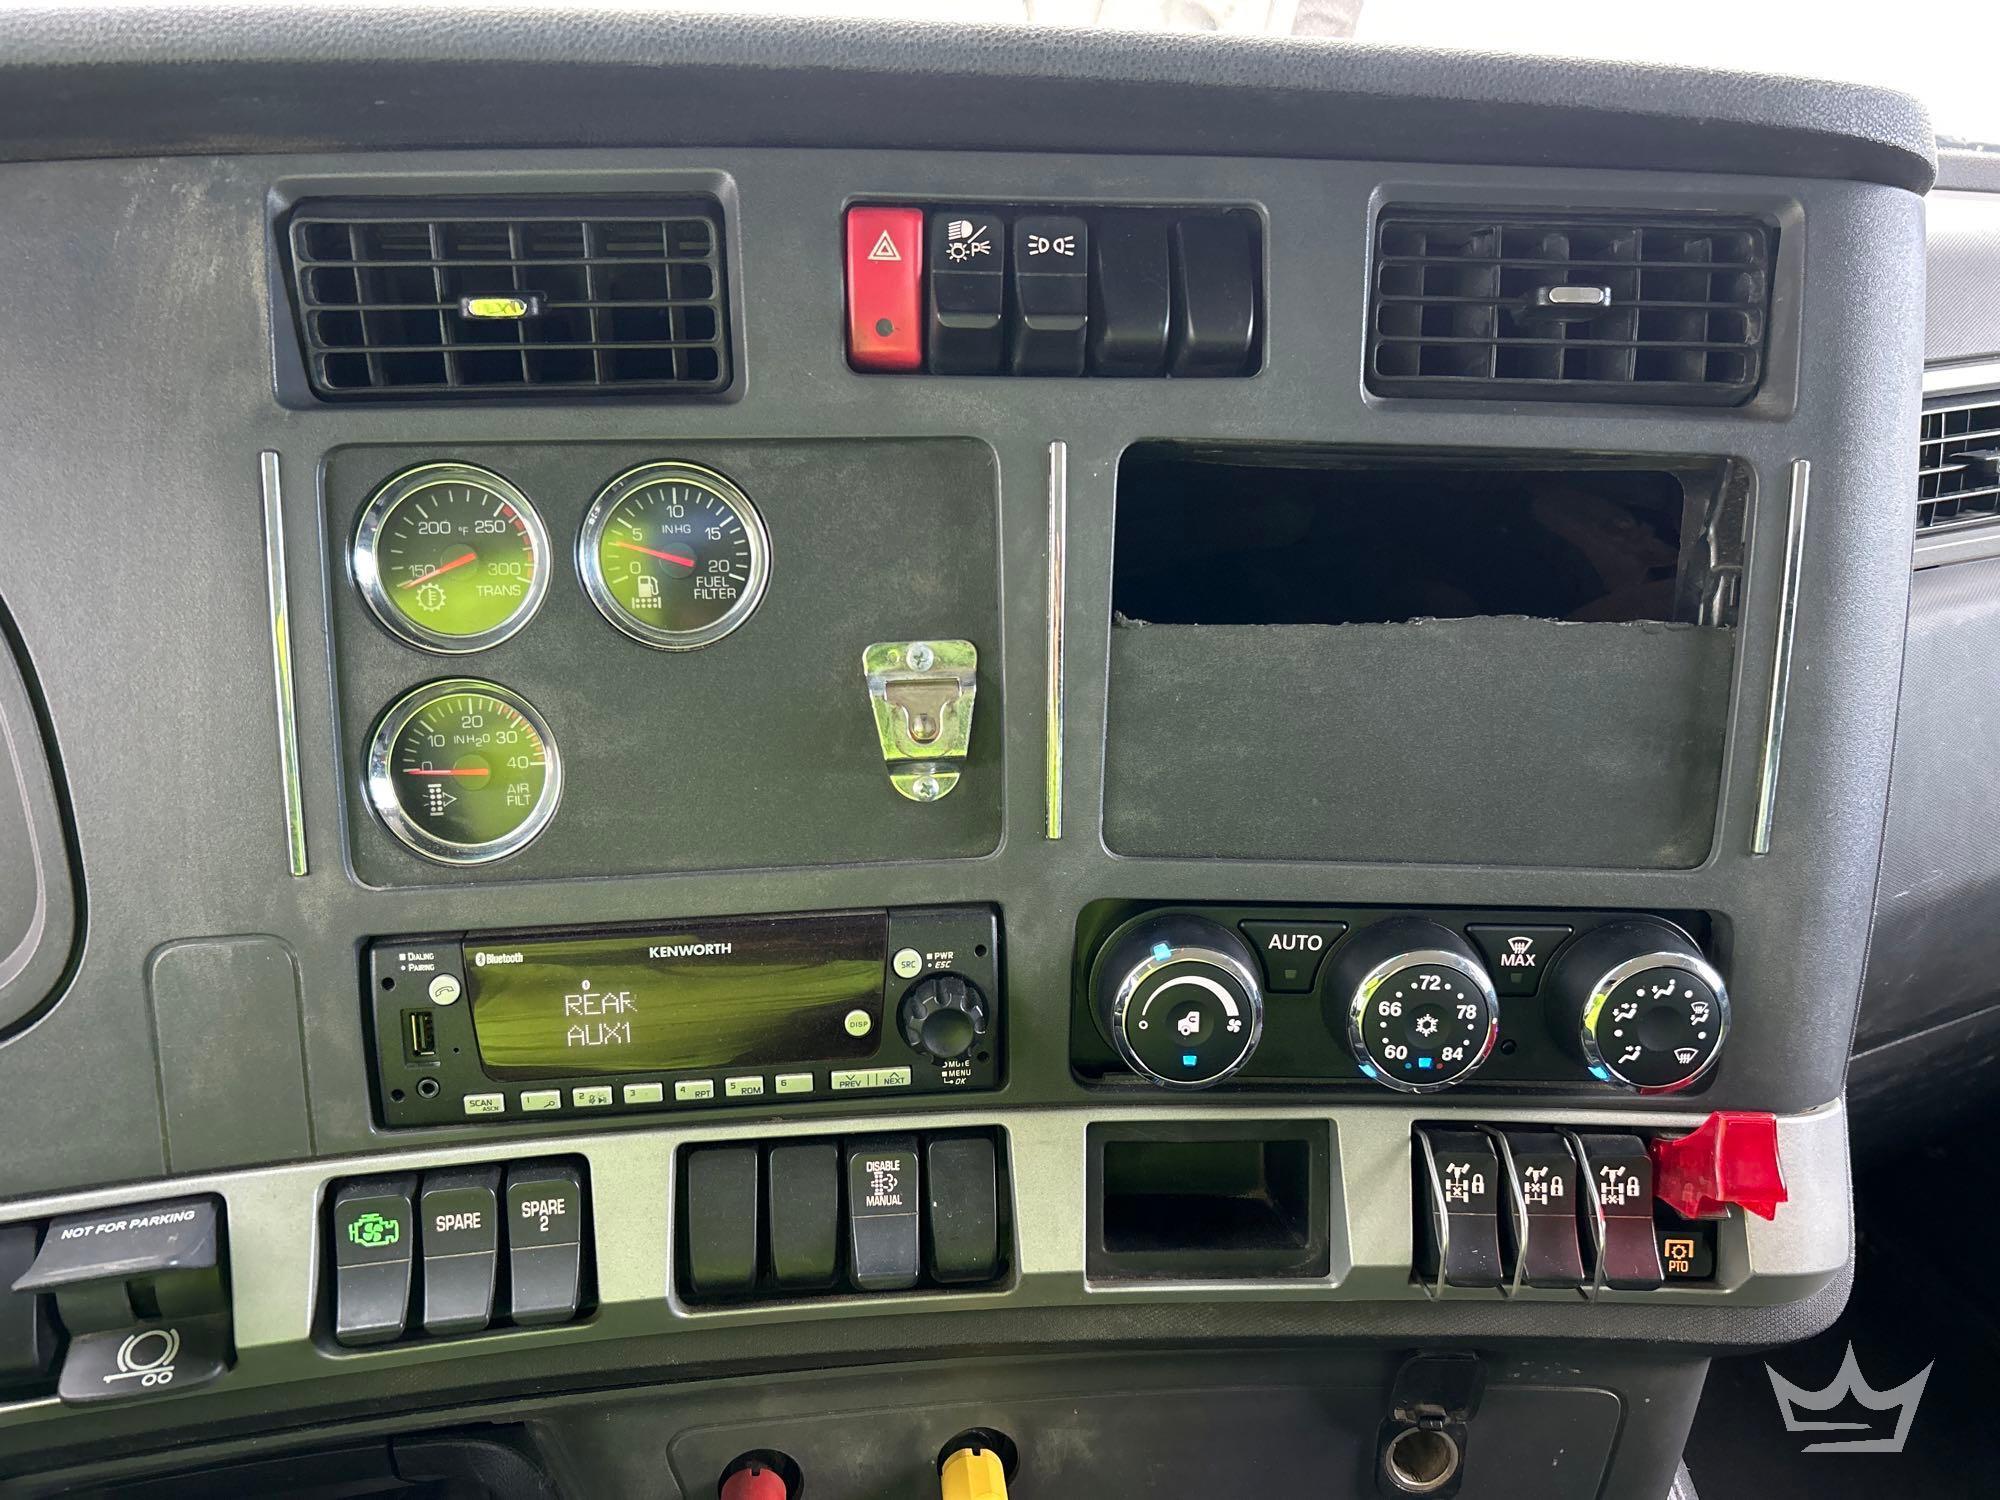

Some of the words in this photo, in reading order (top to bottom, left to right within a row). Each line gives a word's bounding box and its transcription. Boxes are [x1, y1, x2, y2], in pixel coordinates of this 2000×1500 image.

[666, 504, 684, 518] 10
[418, 521, 451, 535] 200
[474, 520, 506, 534] 250
[704, 527, 721, 540] 15
[632, 528, 643, 541] 5
[408, 564, 436, 577] 150
[488, 563, 521, 576] 300
[630, 561, 641, 574] 0
[708, 560, 730, 573] 20
[696, 577, 729, 588] FUEL
[476, 585, 521, 597] TRANS
[694, 588, 737, 599] FILTER
[461, 716, 484, 728] 20
[427, 735, 445, 748] 10
[496, 731, 518, 745] 30
[507, 756, 529, 769] 40
[507, 783, 530, 794] AIR
[506, 795, 532, 806] FILT
[1268, 934, 1323, 951] AUTO
[649, 943, 732, 959] KENWORTH
[934, 952, 954, 960] PWR
[486, 952, 524, 965] Bluetooth
[901, 960, 916, 969] SRC
[935, 961, 952, 969] ESC
[1501, 953, 1536, 967] MAX
[1419, 975, 1441, 991] 72
[1378, 1001, 1402, 1017] 66
[1456, 1004, 1477, 1019] 78
[567, 1021, 632, 1047] AUX1
[1384, 1046, 1408, 1060] 60
[1441, 1047, 1463, 1061] 84
[948, 1069, 971, 1077] MENU
[730, 1082, 736, 1090] 5
[780, 1079, 787, 1087] 6
[839, 1080, 862, 1088] PREV
[883, 1077, 905, 1085] NEXT
[955, 1077, 967, 1085] OK
[578, 1092, 585, 1100] 2
[629, 1089, 636, 1097] 3
[680, 1086, 686, 1094] 4
[694, 1090, 711, 1098] RPT
[741, 1087, 761, 1095] ROM
[469, 1099, 493, 1108] SCAN
[866, 1160, 901, 1173] DISABLE
[866, 1195, 902, 1207] MANUAL
[521, 1198, 566, 1218] SPARE
[60, 1226, 95, 1240] NOT
[94, 1221, 127, 1235] FOR
[129, 1210, 196, 1229] PARKING
[436, 1212, 482, 1232] SPARE
[539, 1215, 550, 1232] 2
[1668, 1260, 1689, 1272] PTO
